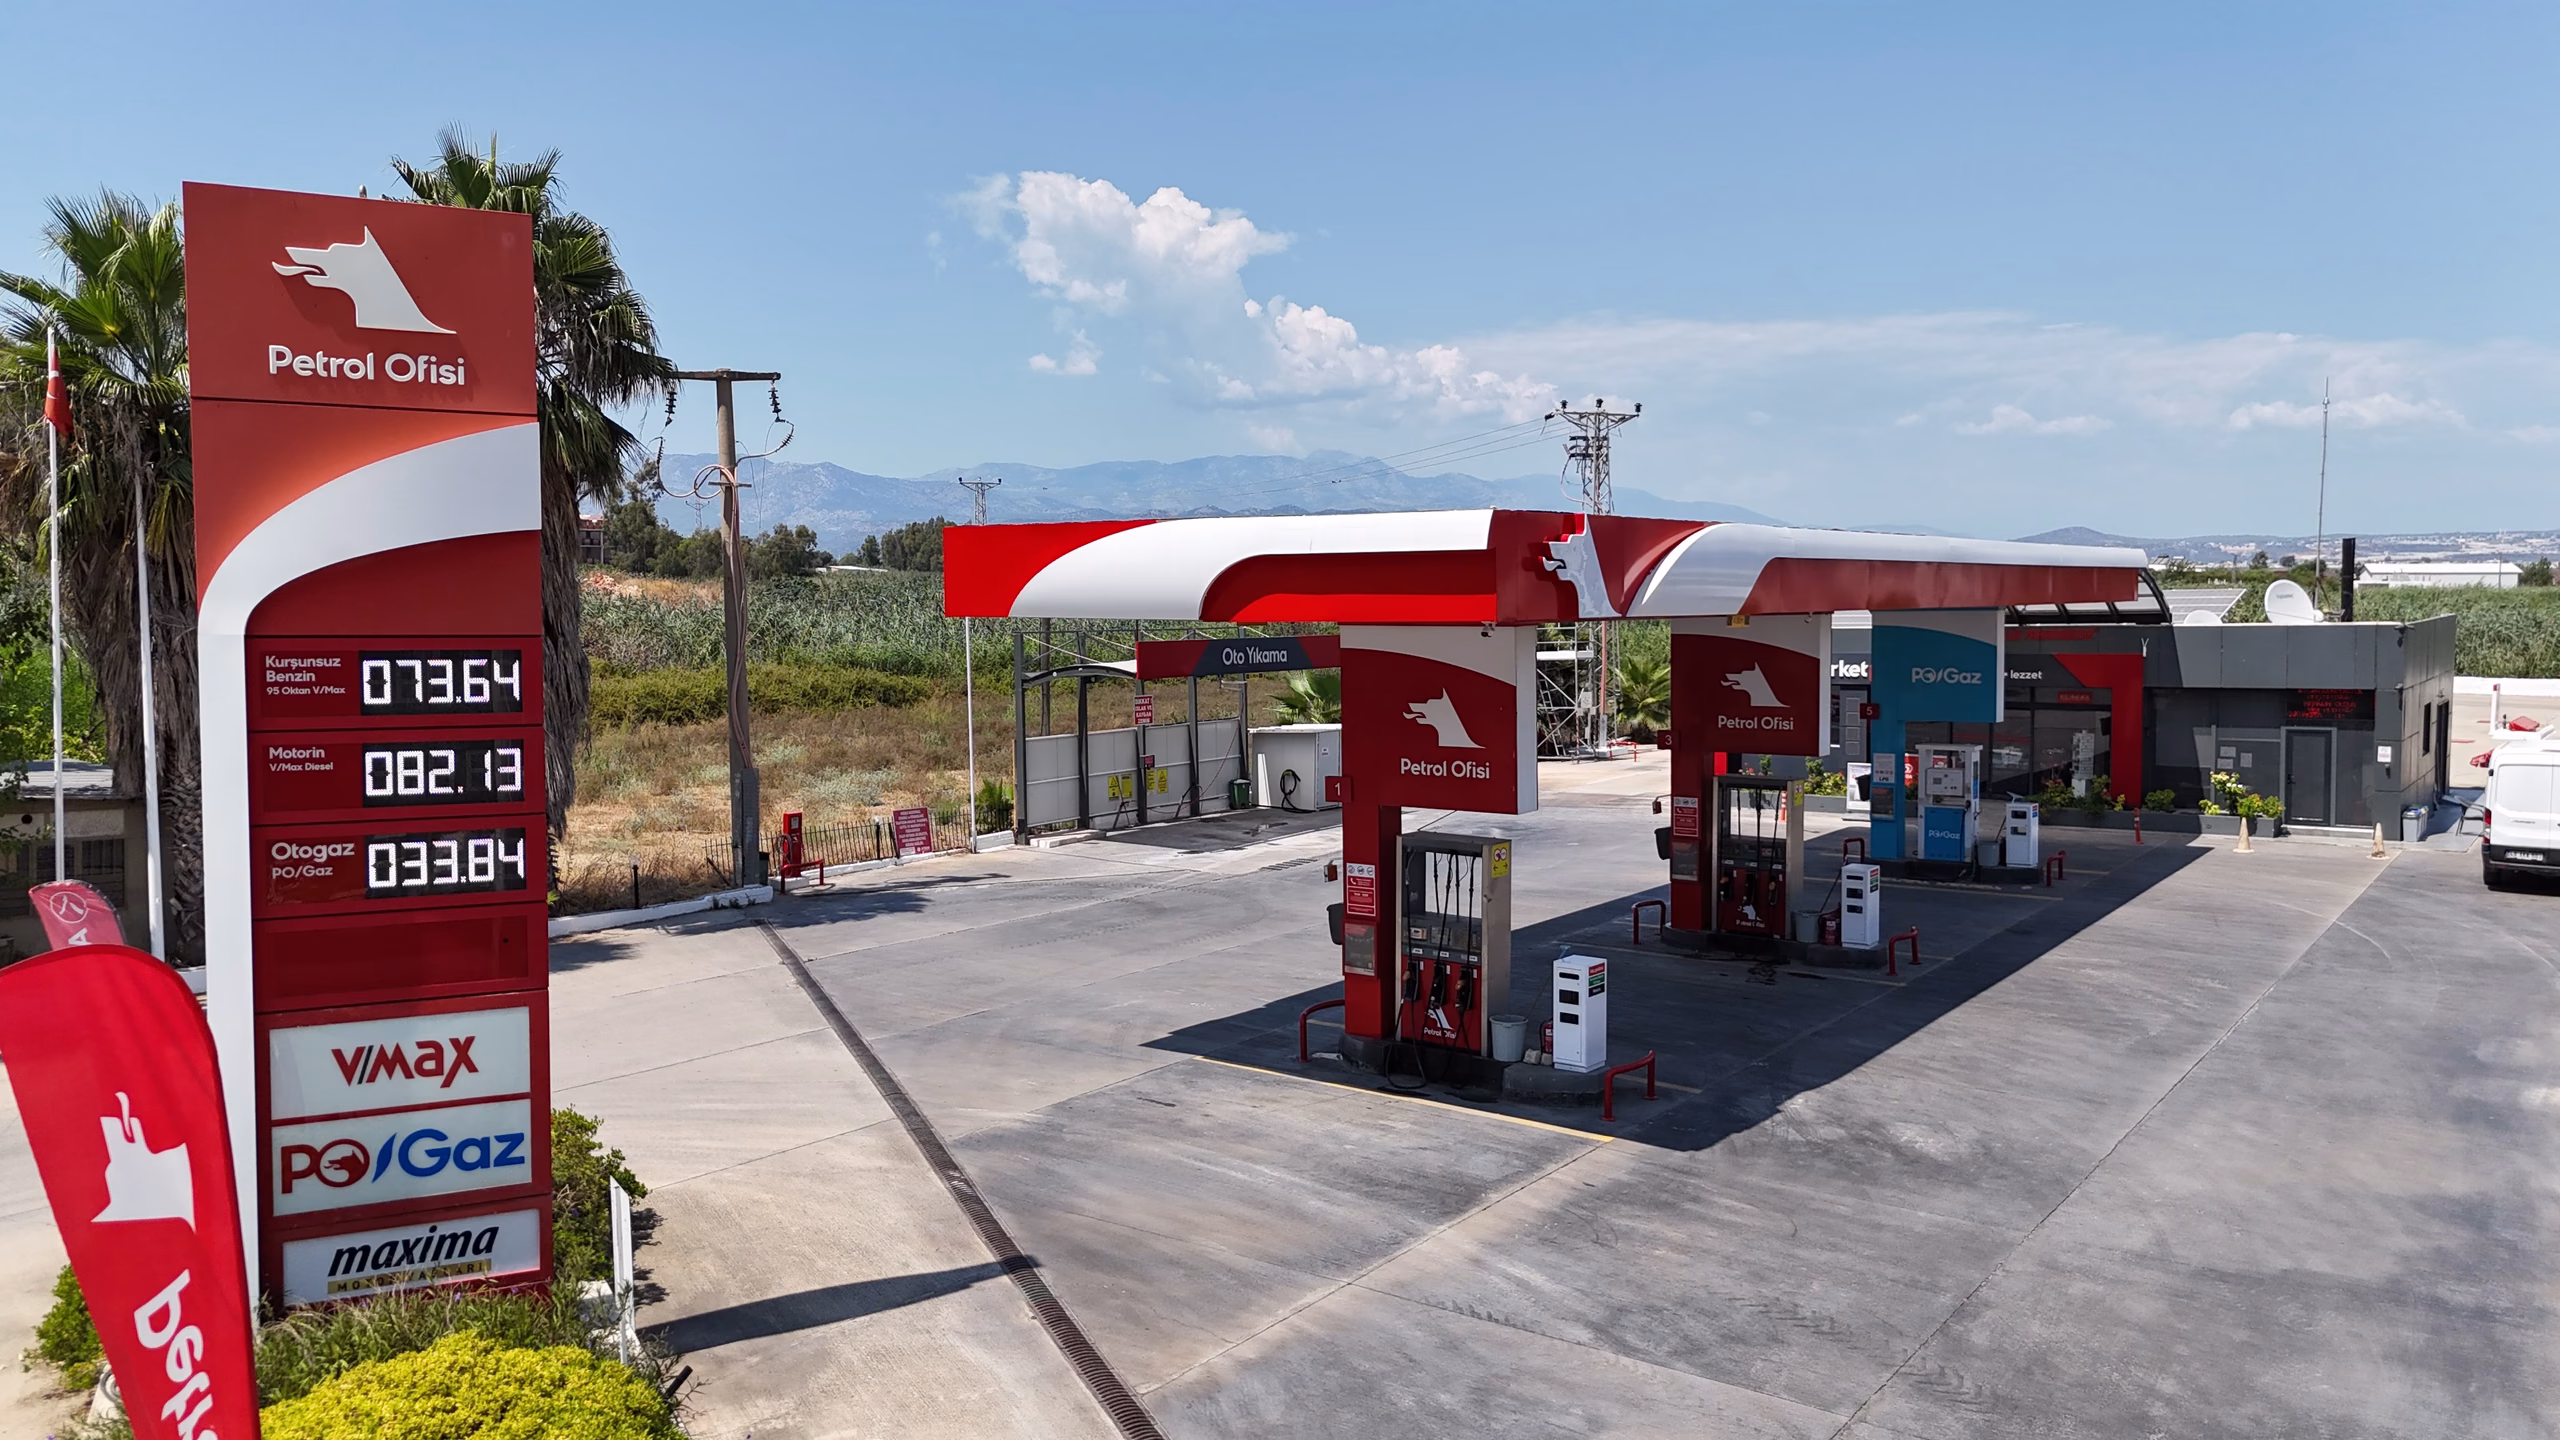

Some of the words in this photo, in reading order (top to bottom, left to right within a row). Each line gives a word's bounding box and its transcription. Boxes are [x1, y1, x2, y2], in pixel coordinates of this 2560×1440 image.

[268, 344, 375, 381] Petrol
[384, 352, 465, 386] Ofisi
[265, 655, 342, 670] Kurşunsuz
[1222, 647, 1245, 666] Oto
[1246, 646, 1288, 664] Yıkama
[1830, 659, 1869, 677] rket
[2010, 669, 2043, 679] lezzet
[266, 670, 316, 682] Benzin
[362, 658, 520, 705] 073.64
[266, 686, 280, 695] 95
[281, 686, 311, 695] Oktan
[312, 685, 346, 694] V/Max
[1866, 706, 1873, 715] 5
[1718, 715, 1758, 729] Petrol
[1760, 716, 1794, 730] Ofisi
[1665, 735, 1673, 745] 3
[269, 747, 325, 759] Motorin
[269, 762, 303, 772] V/Max
[304, 762, 334, 771] Diesel
[364, 748, 521, 796] 082.13
[1400, 758, 1447, 777] Petrol
[1451, 760, 1490, 779] Ofisi
[1334, 782, 1341, 796] 1
[271, 842, 355, 862] Otogaz
[368, 838, 525, 888] 033.84
[271, 865, 333, 879] PO/Gaz
[327, 1224, 500, 1277] maxima
